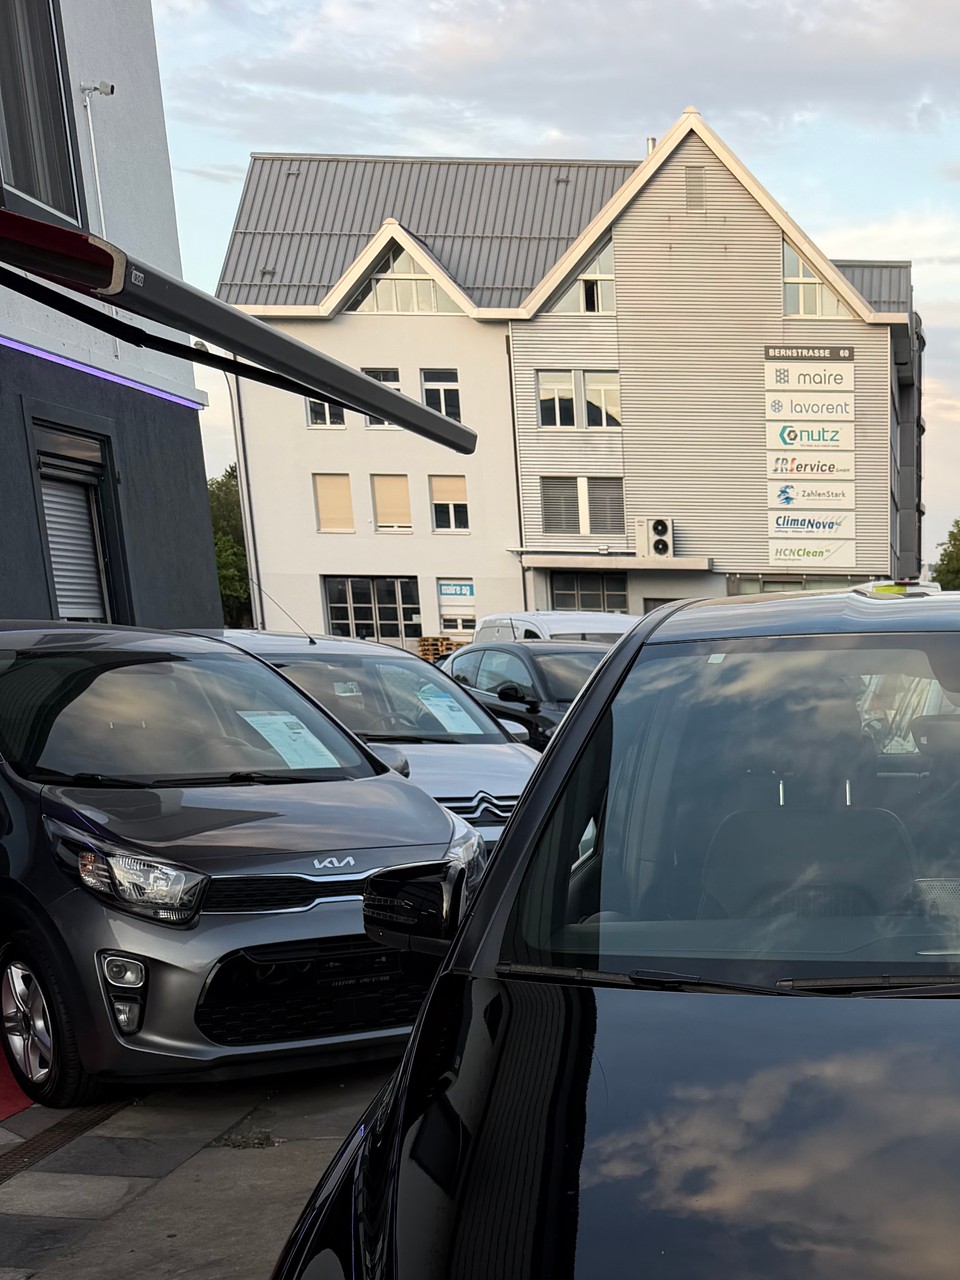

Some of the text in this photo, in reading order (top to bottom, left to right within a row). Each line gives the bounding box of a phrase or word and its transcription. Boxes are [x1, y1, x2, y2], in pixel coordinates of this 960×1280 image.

[768, 349, 849, 358] BERNSTRASSE 60
[797, 369, 844, 385] maire
[790, 399, 850, 414] lavorent
[802, 490, 846, 498] ZahlenStark
[775, 516, 835, 530] ClimaNova
[775, 548, 825, 557] HCNClean
[313, 856, 355, 869] KIA
